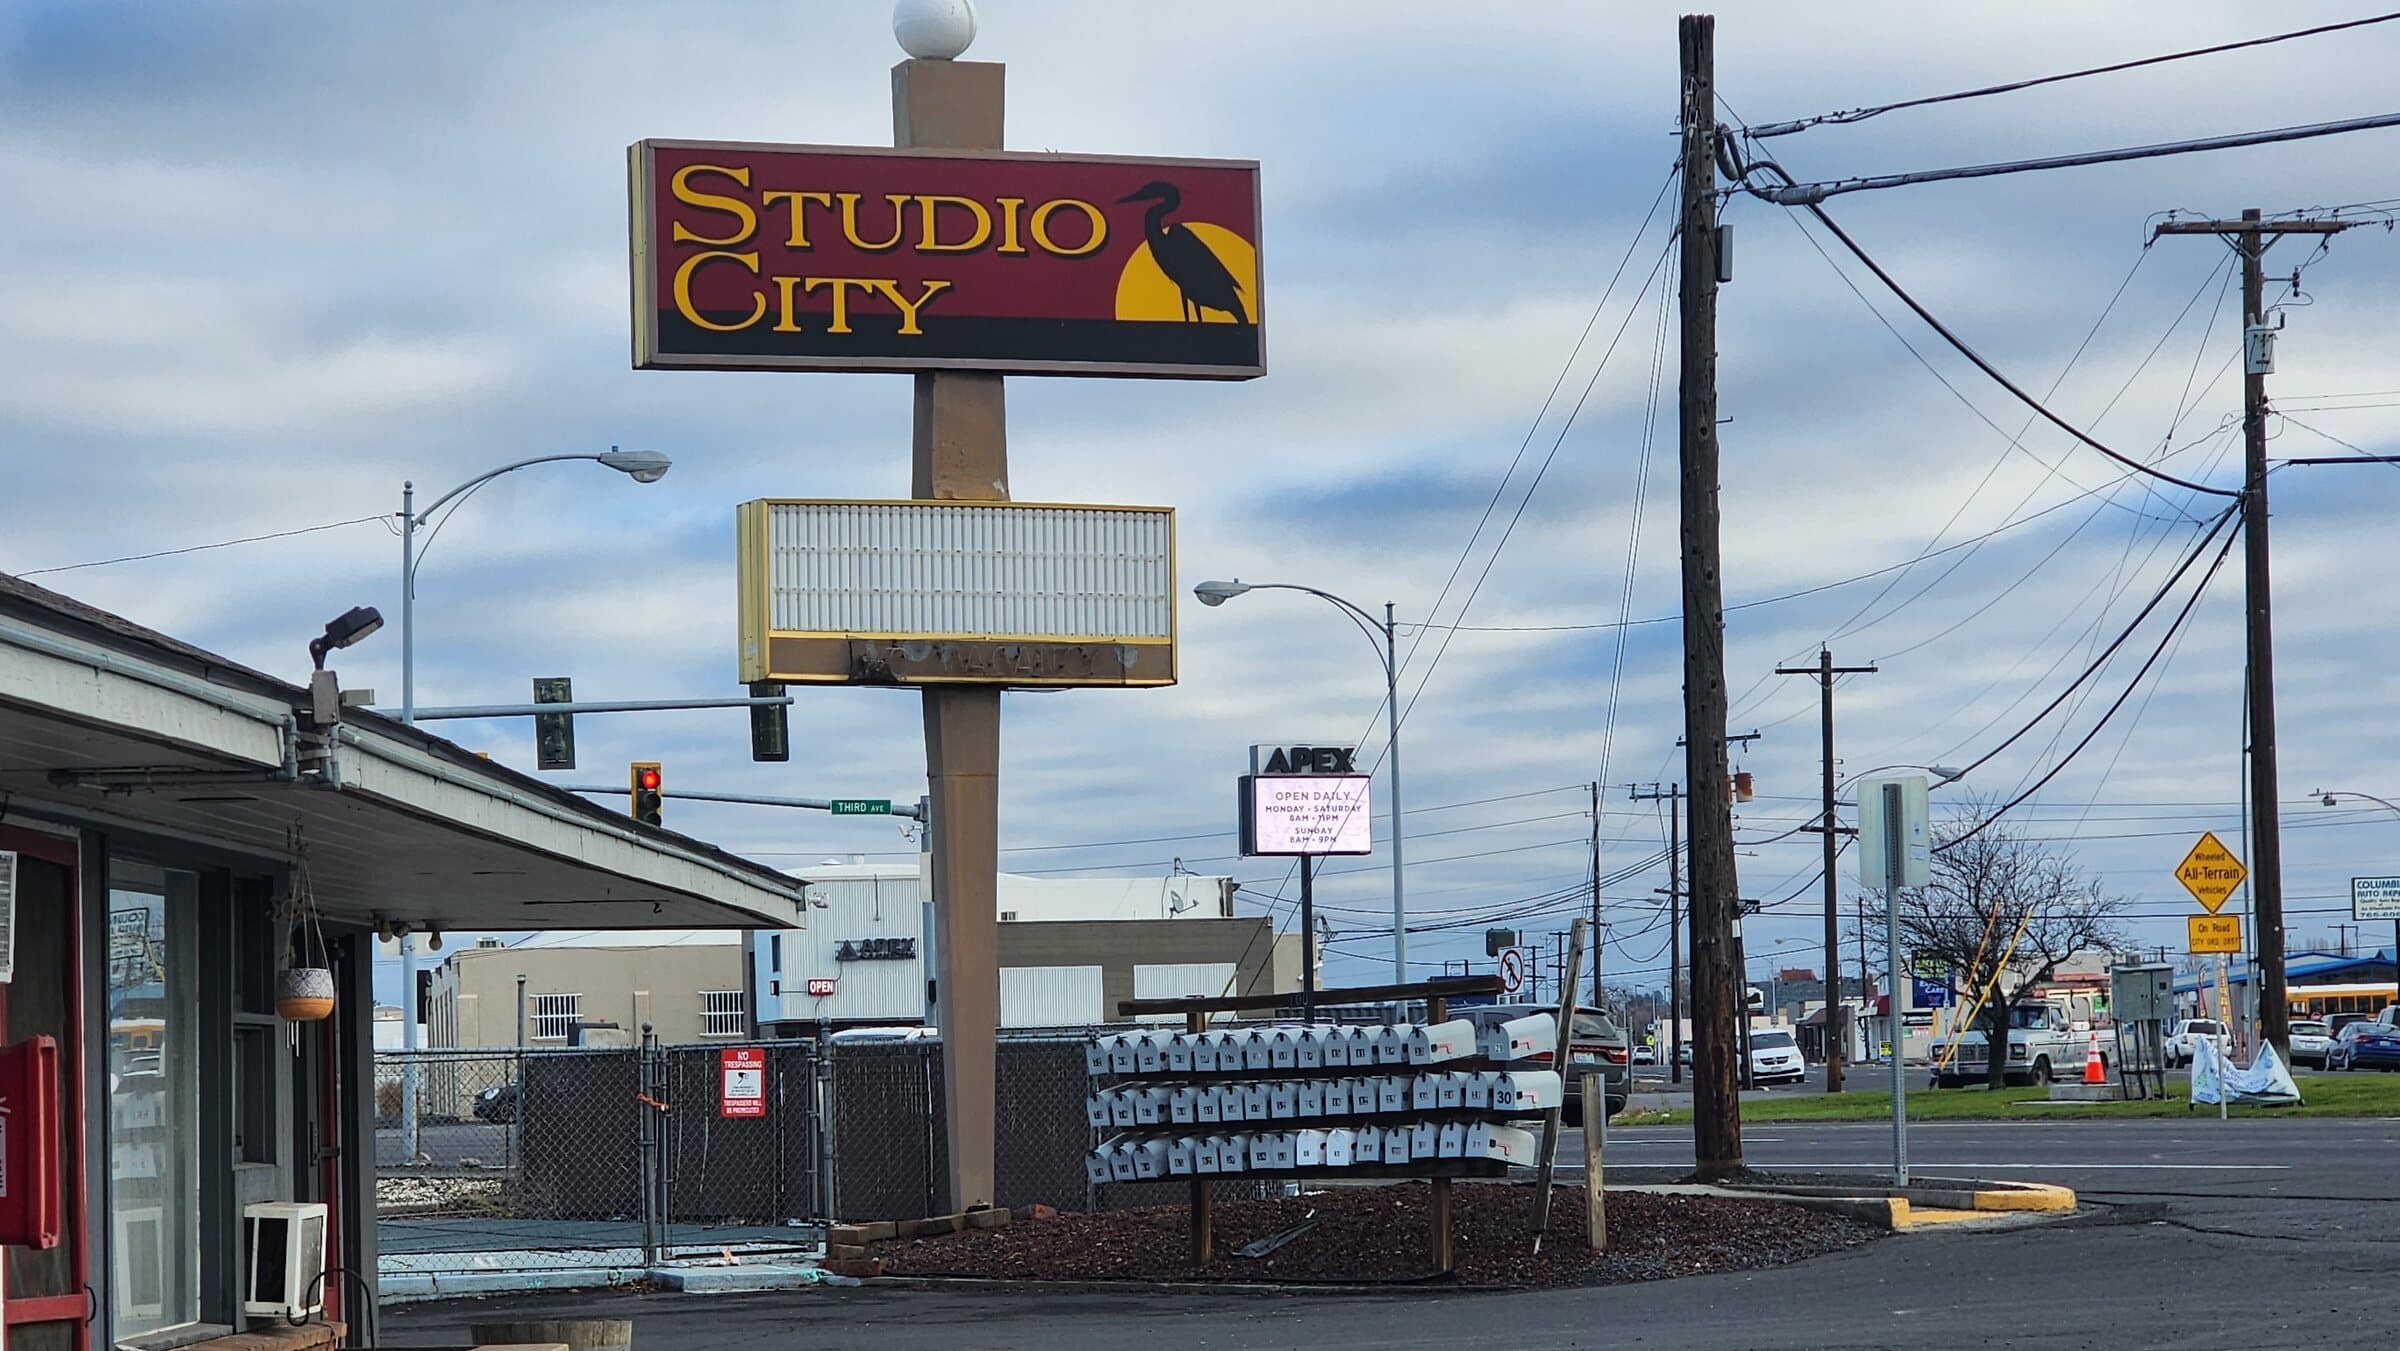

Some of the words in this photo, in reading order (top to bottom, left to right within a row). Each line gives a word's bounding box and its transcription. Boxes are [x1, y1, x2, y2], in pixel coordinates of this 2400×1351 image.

[1264, 747, 1355, 773] APEX
[1275, 792, 1309, 801] OPEN
[1313, 792, 1351, 801] DAILY
[838, 802, 867, 812] THIRD
[1265, 805, 1304, 813] MONDAY
[1313, 805, 1361, 813] SATURDAY
[1295, 827, 1333, 835] SUNDAY
[2195, 852, 2226, 861] Wheeled
[2183, 866, 2240, 880] All-Terrain
[2198, 886, 2227, 894] Vehicles
[2198, 923, 2208, 933] On
[2213, 923, 2231, 933] Road
[861, 938, 916, 953] APEX
[809, 981, 833, 993] OPEN
[737, 1051, 749, 1061] NO
[1497, 1091, 1512, 1104] 30
